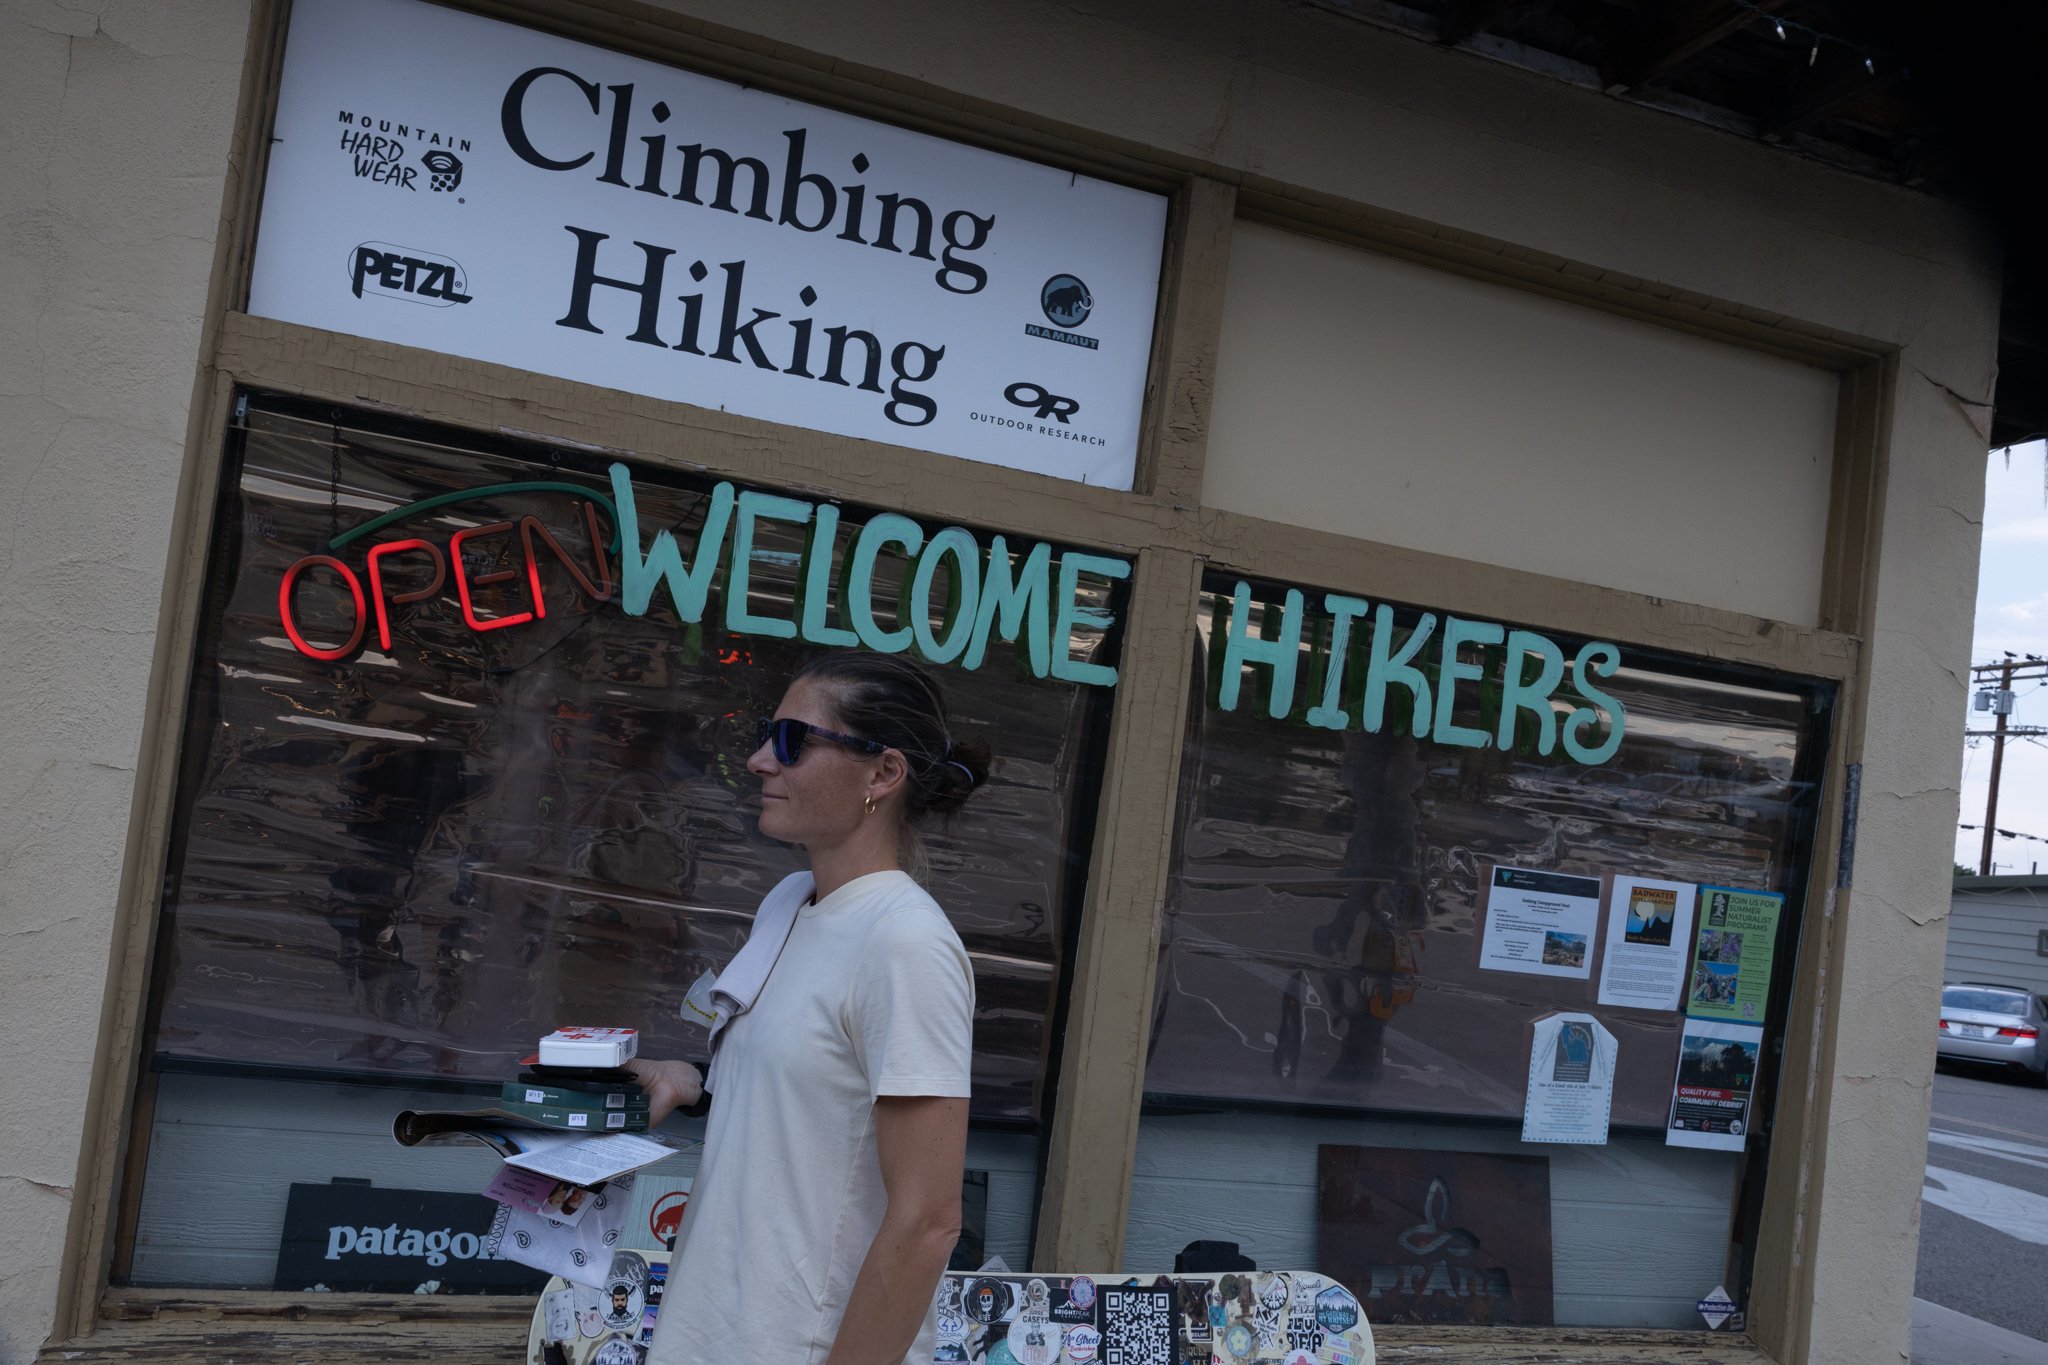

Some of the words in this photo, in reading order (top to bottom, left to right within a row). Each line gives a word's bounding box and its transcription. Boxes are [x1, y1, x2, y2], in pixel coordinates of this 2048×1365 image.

[338, 110, 471, 153] MOUNTAIN
[340, 129, 404, 163] HARD
[354, 154, 418, 191] WEAR
[501, 66, 995, 294] Climbing
[352, 246, 473, 304] PETZL
[555, 225, 945, 427] Hiking
[1026, 322, 1098, 349] MAMMUT
[1003, 381, 1080, 424] OR
[970, 411, 1033, 432] OUTDOOR
[1038, 425, 1106, 448] RESEARCH
[279, 501, 613, 661] OPEN
[607, 462, 1132, 687] WELCOME
[1219, 580, 1626, 766] HIKERS
[1633, 888, 1674, 900] BADWATER
[1728, 904, 1761, 914] SUMMER
[1730, 896, 1748, 905] JOIN
[1726, 922, 1768, 932] PROGRAMS
[1728, 913, 1772, 924] NATURALIST
[1679, 1098, 1717, 1106] COMMUNITY
[1680, 1088, 1707, 1096] QUALITY
[325, 1222, 512, 1266] patago
[1022, 1316, 1049, 1324] CASEYS
[1294, 1305, 1316, 1314] PIZZ
[1704, 1303, 1726, 1311] Protection
[1076, 1334, 1101, 1346] Street
